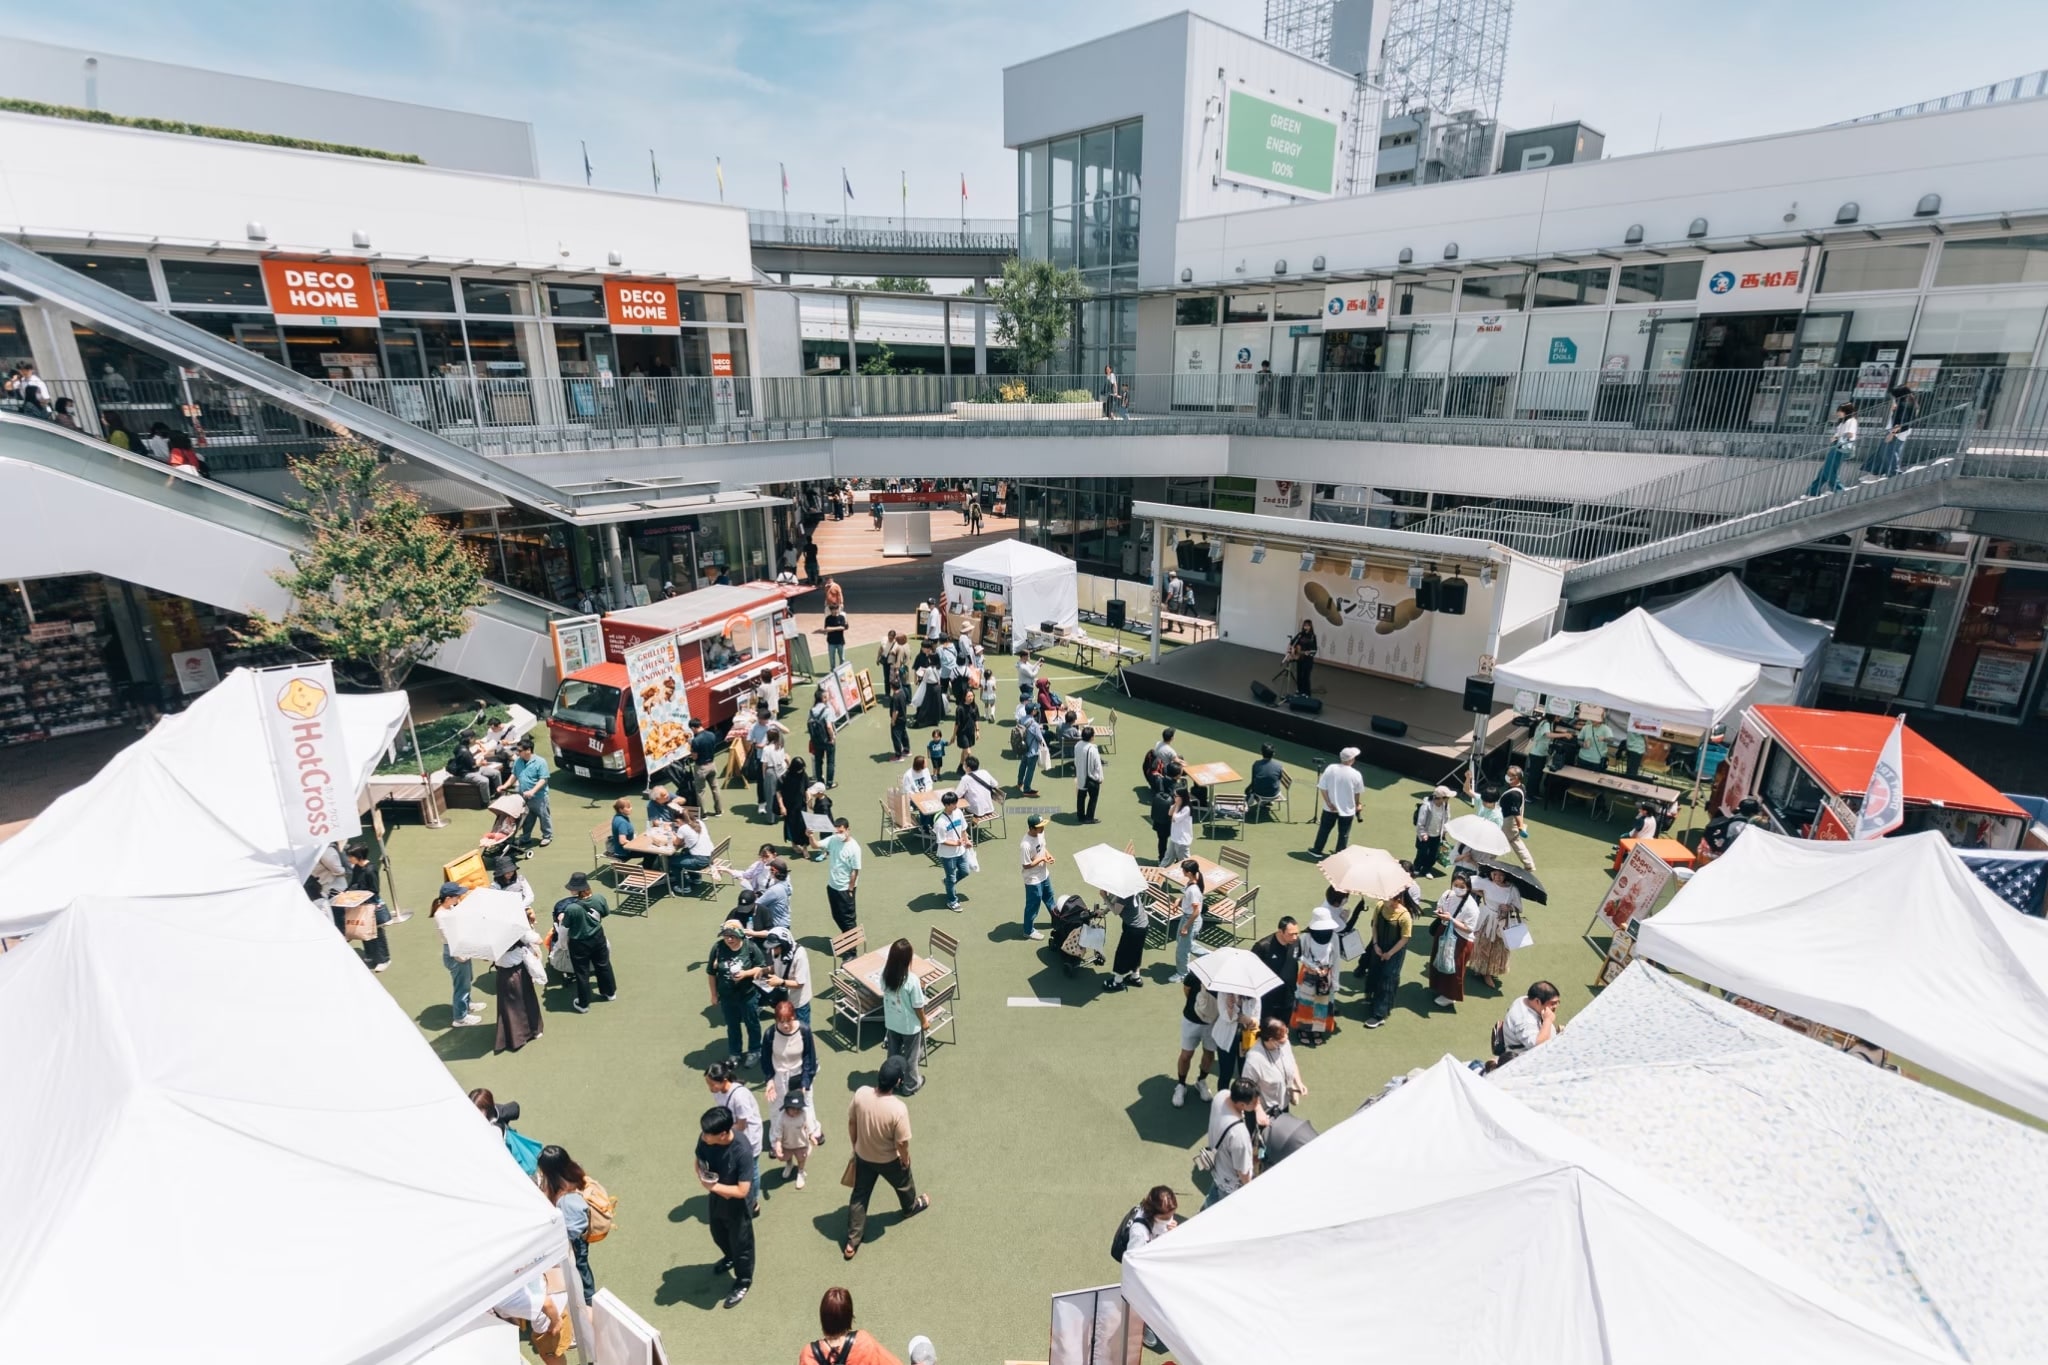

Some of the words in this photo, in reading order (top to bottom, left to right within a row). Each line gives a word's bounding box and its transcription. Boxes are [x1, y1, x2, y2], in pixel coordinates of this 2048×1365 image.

[1270, 113, 1302, 134] GREEN
[1266, 136, 1302, 157] ENERGY
[1520, 145, 1554, 172] P
[1271, 160, 1293, 178] 100%
[284, 270, 354, 289] DECO
[1740, 270, 1799, 288] 西松屋
[289, 290, 359, 308] HOME
[620, 289, 666, 304] DECO
[621, 305, 667, 319] HOME
[954, 576, 979, 588] CRITTERS
[979, 581, 1002, 593] BURGER
[637, 646, 666, 661] GRILLED
[637, 665, 674, 682] SANDWICH
[641, 657, 665, 672] CHEESE
